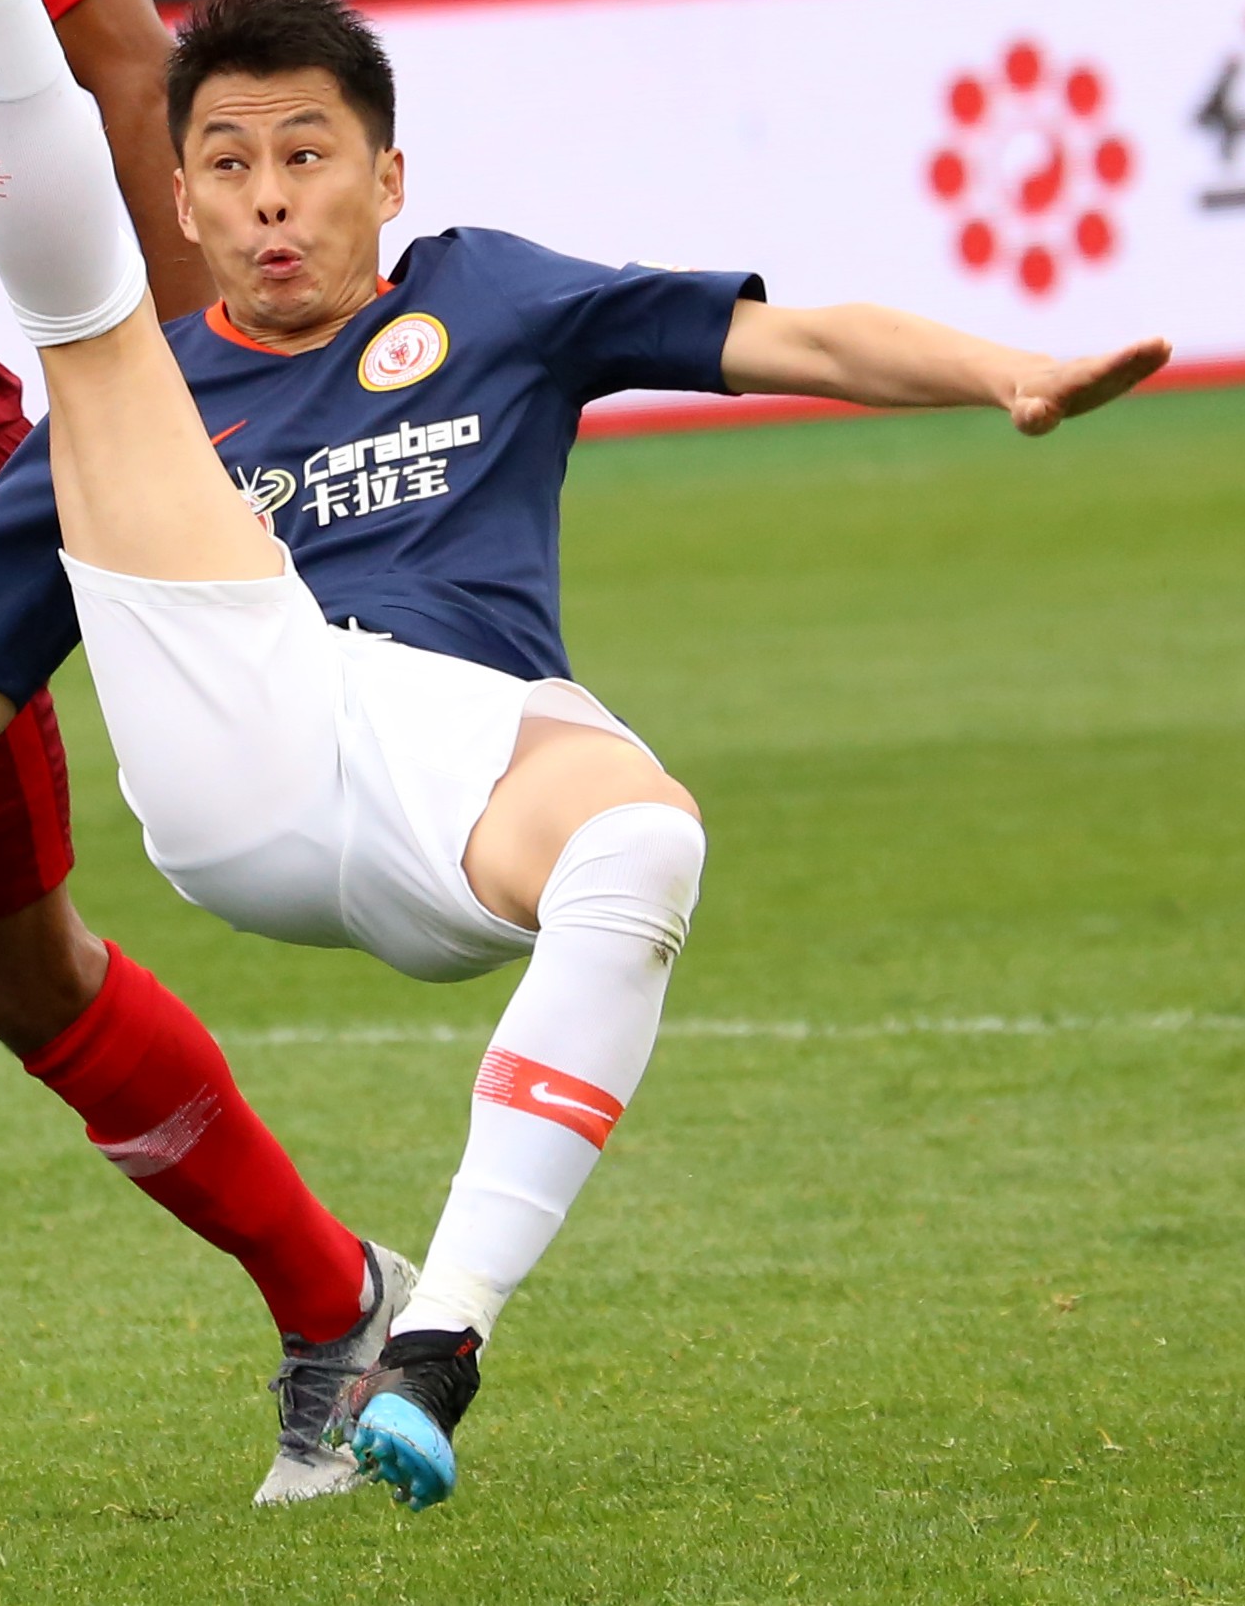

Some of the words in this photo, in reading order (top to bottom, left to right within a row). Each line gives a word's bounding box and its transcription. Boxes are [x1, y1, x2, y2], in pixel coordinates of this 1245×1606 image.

[304, 414, 481, 489] Carabao
[301, 456, 450, 527] 卡拉宝
